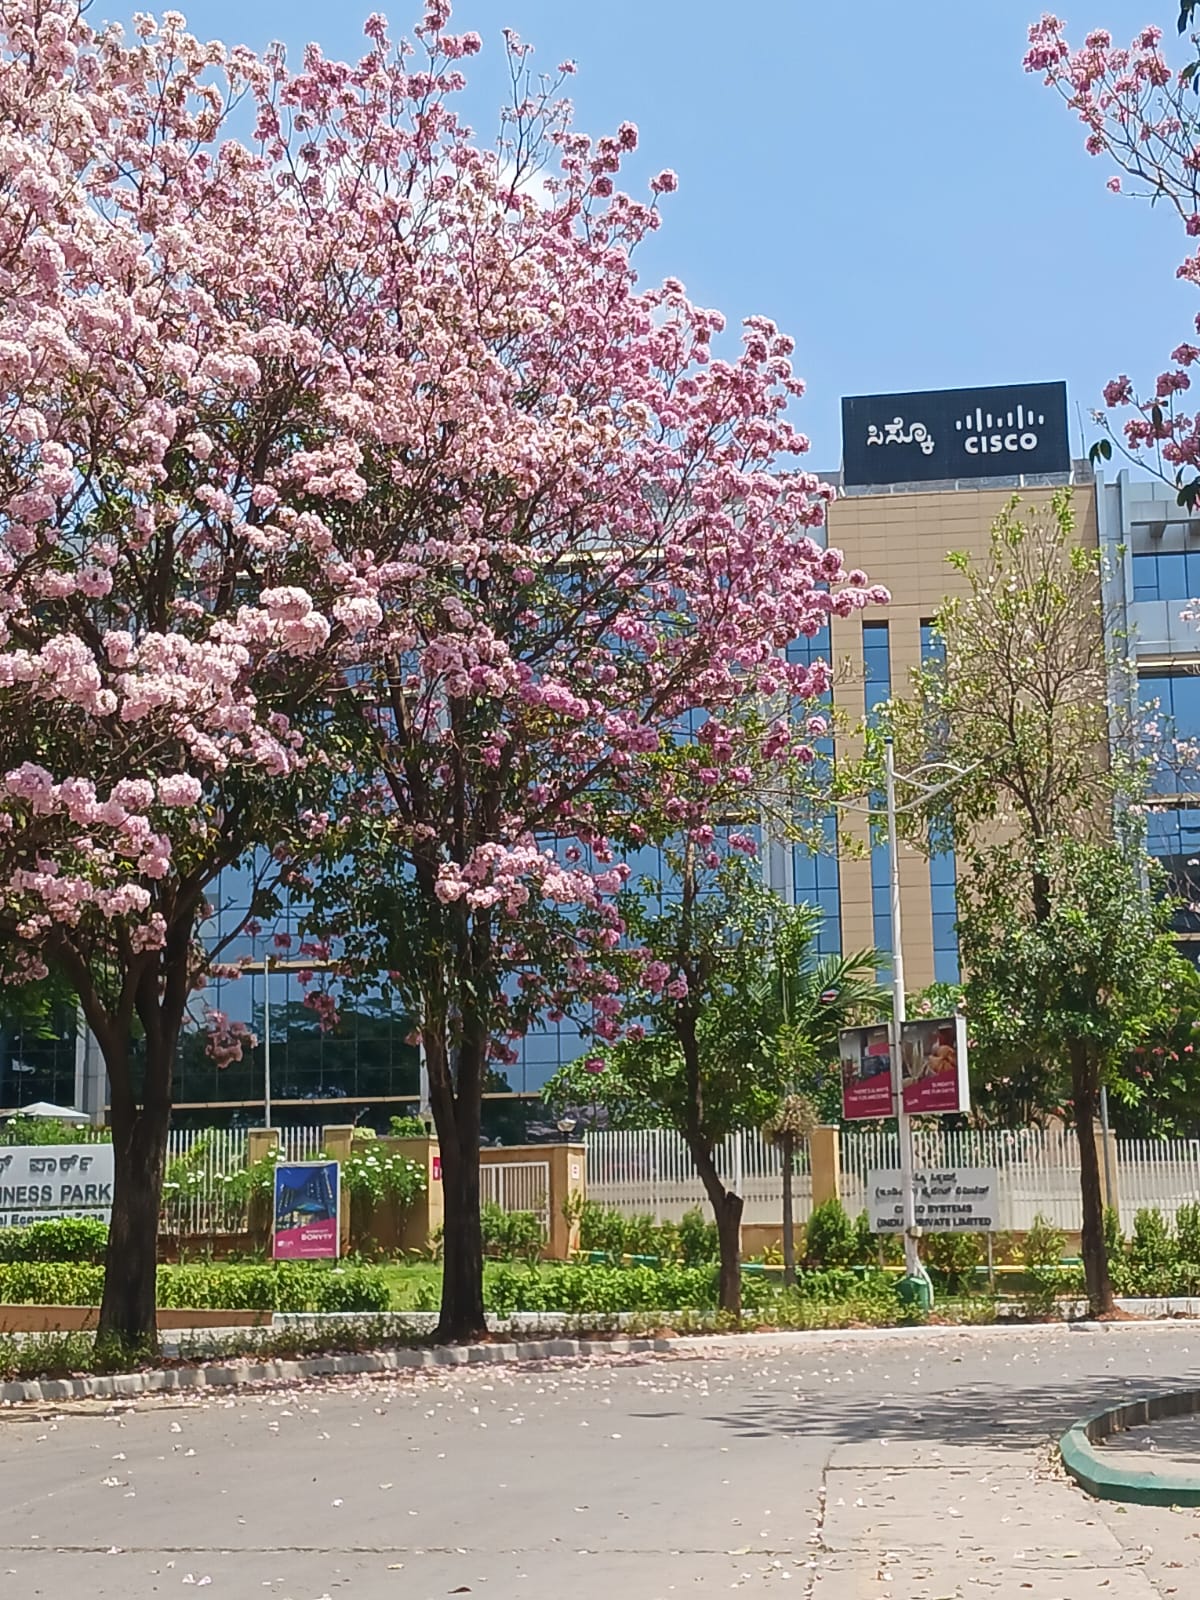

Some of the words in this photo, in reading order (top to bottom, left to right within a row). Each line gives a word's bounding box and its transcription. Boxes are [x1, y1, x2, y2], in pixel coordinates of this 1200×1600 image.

[60, 1183, 111, 1201] PARK
[928, 1204, 972, 1213] SYSTEMS
[953, 1217, 992, 1226] LIMITED
